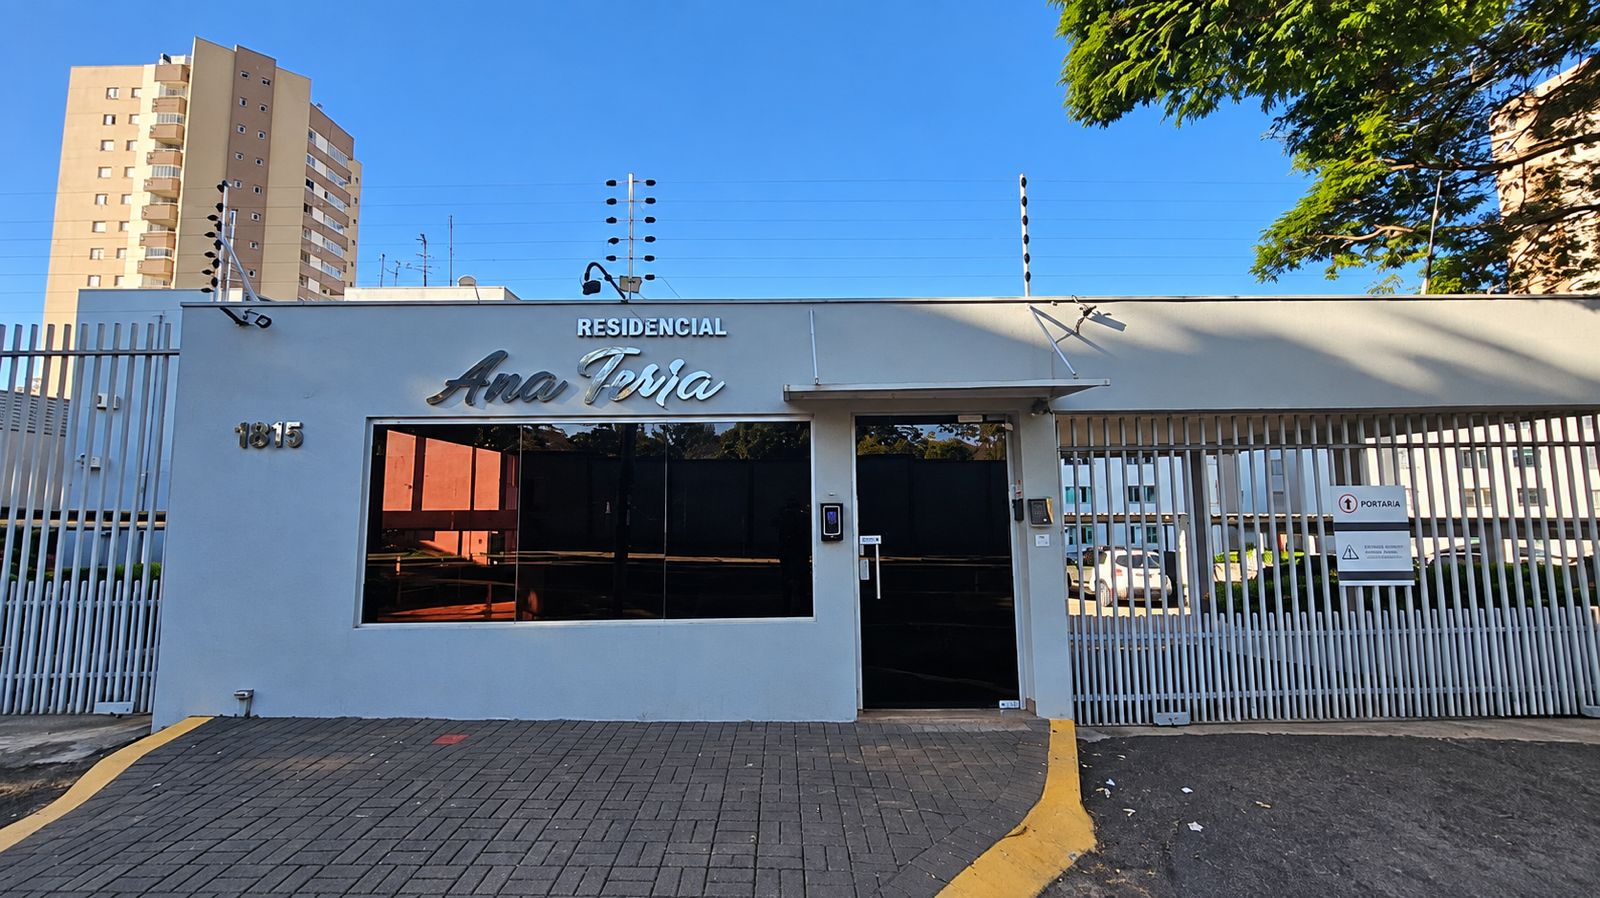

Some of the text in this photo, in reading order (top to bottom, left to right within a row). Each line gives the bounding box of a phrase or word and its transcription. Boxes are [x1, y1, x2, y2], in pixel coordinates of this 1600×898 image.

[576, 317, 727, 337] RESIDENCIAL
[426, 345, 726, 408] Ana Terra
[234, 421, 304, 449] 1815
[1360, 500, 1401, 508] PORTARIA
